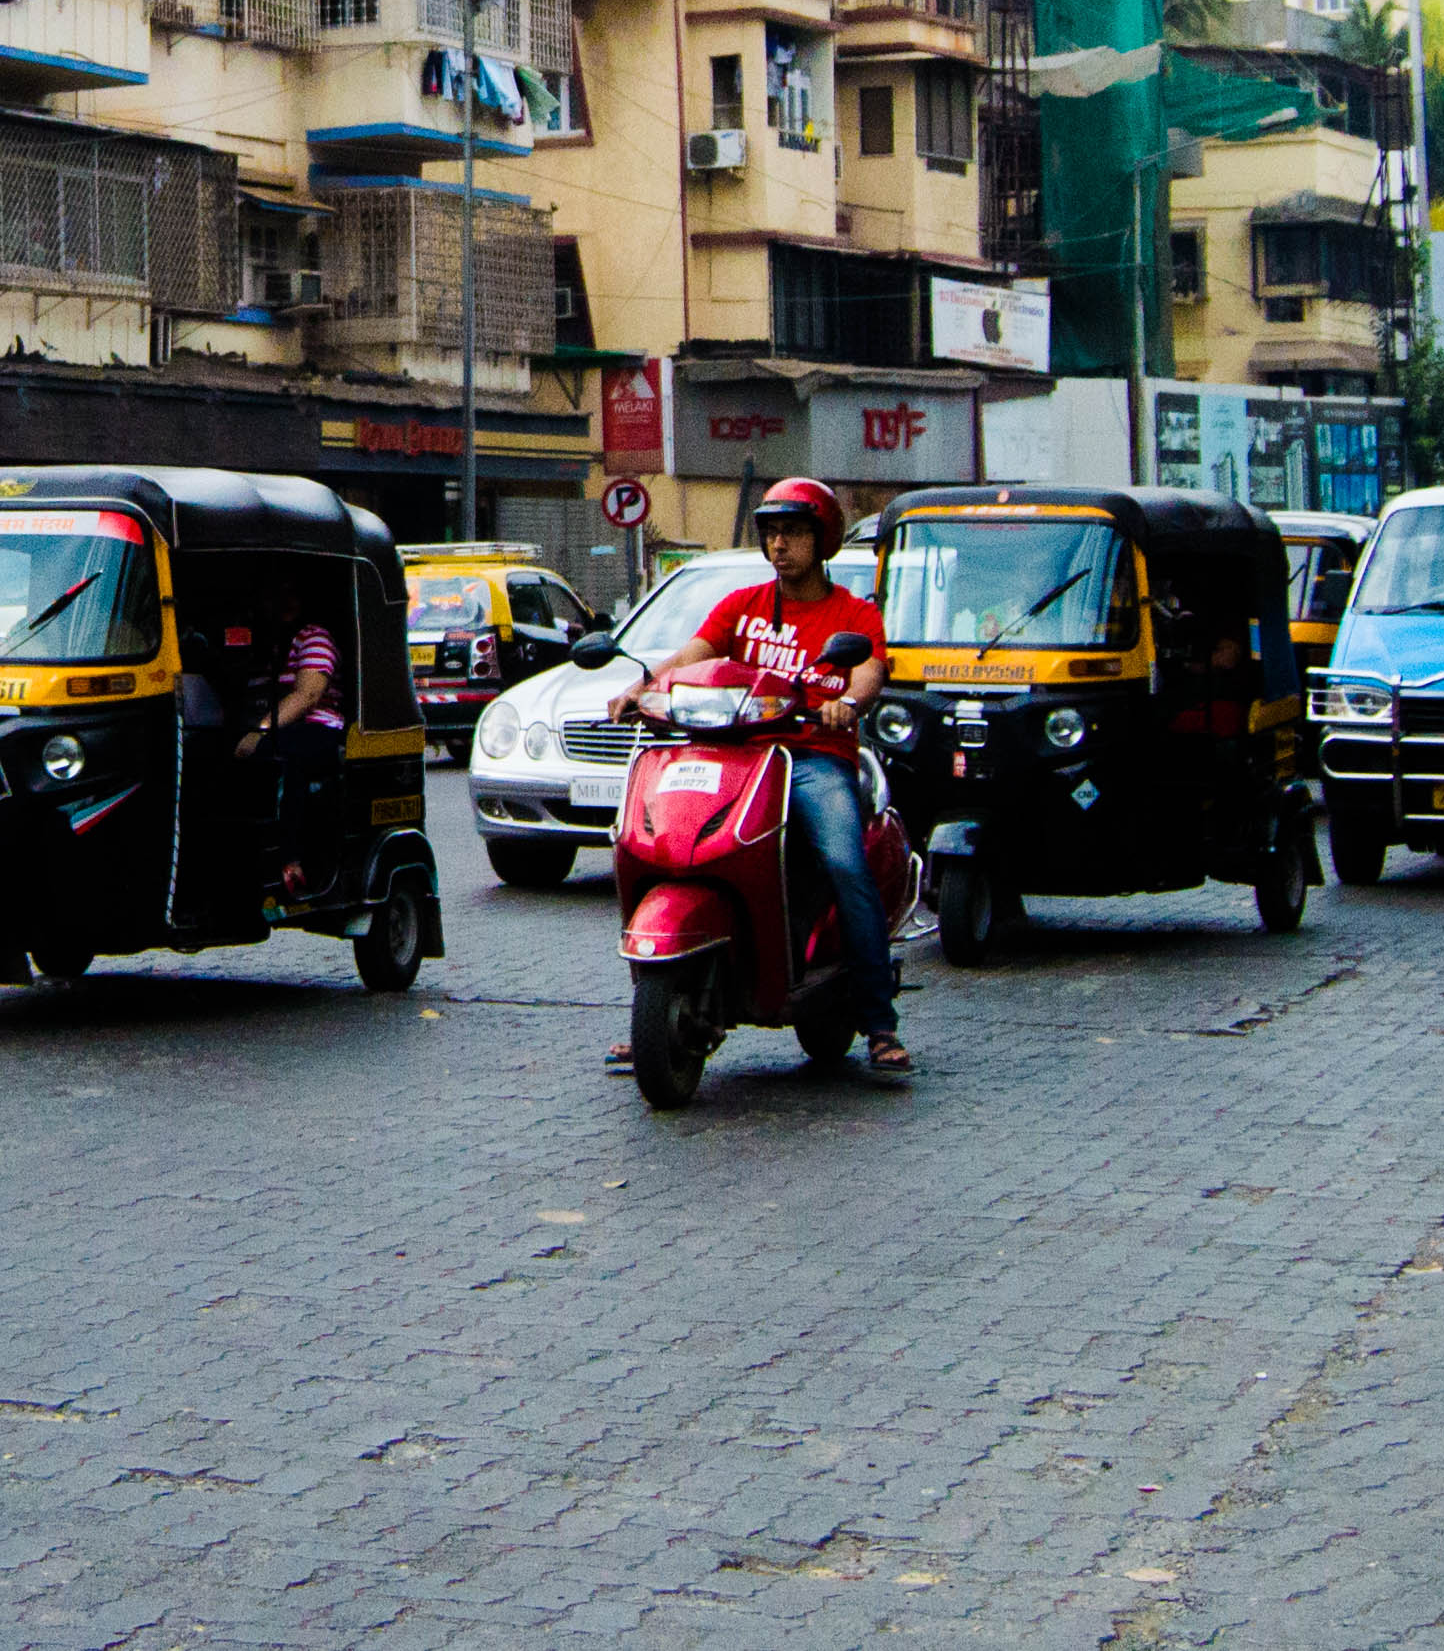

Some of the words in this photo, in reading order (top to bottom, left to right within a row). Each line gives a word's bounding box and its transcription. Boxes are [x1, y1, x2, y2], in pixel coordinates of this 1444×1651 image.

[735, 614, 749, 637] I
[746, 617, 799, 647] CAN.
[744, 641, 754, 663] I
[576, 785, 601, 799] MH
[607, 786, 622, 799] 02
